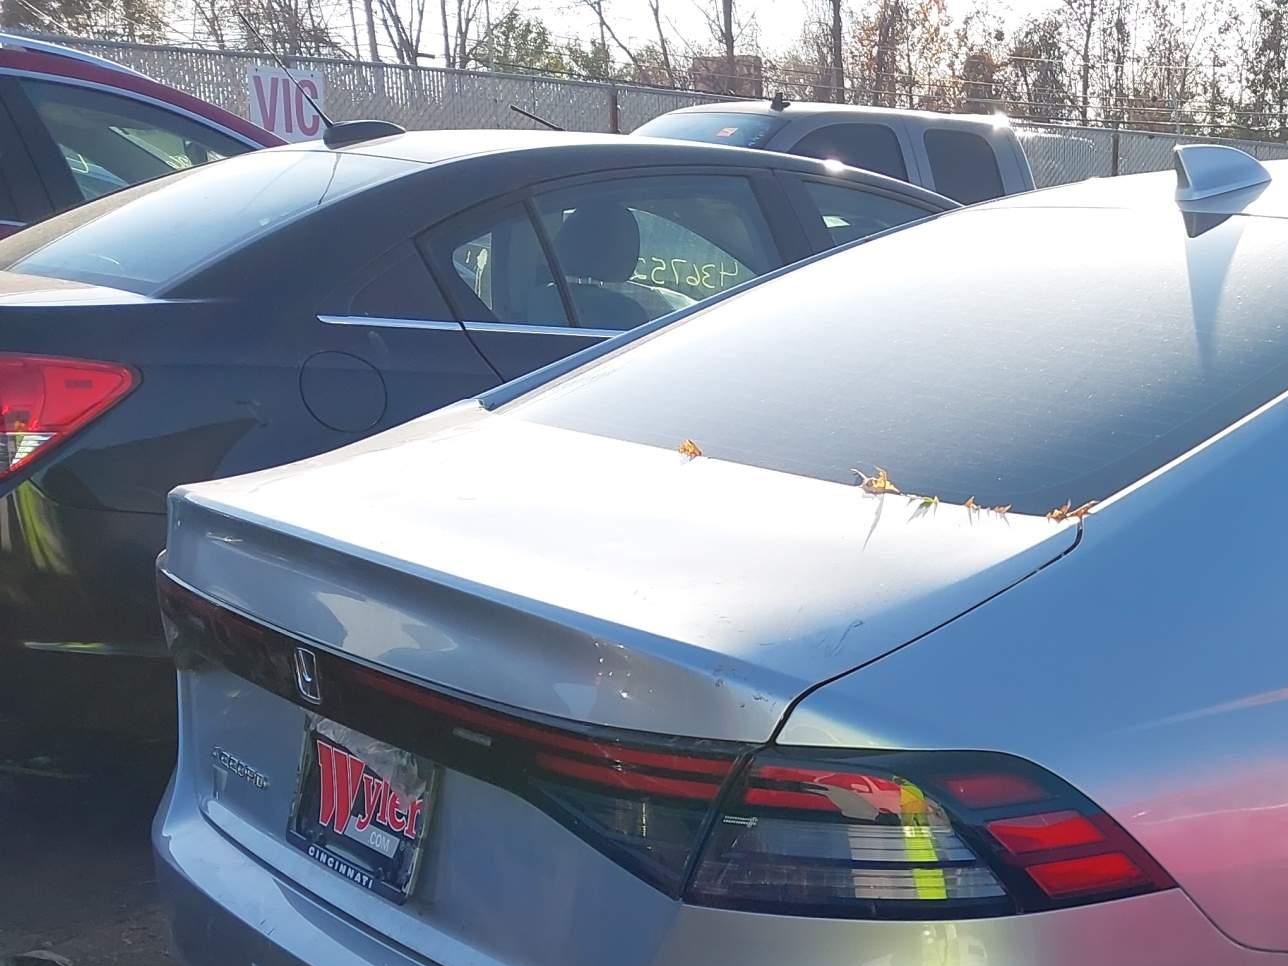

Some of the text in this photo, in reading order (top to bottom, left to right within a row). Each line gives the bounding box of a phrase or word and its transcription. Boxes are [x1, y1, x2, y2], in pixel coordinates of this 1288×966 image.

[253, 75, 320, 137] VIC
[316, 739, 424, 840] Wyler
[307, 845, 375, 890] CINCINNATI
